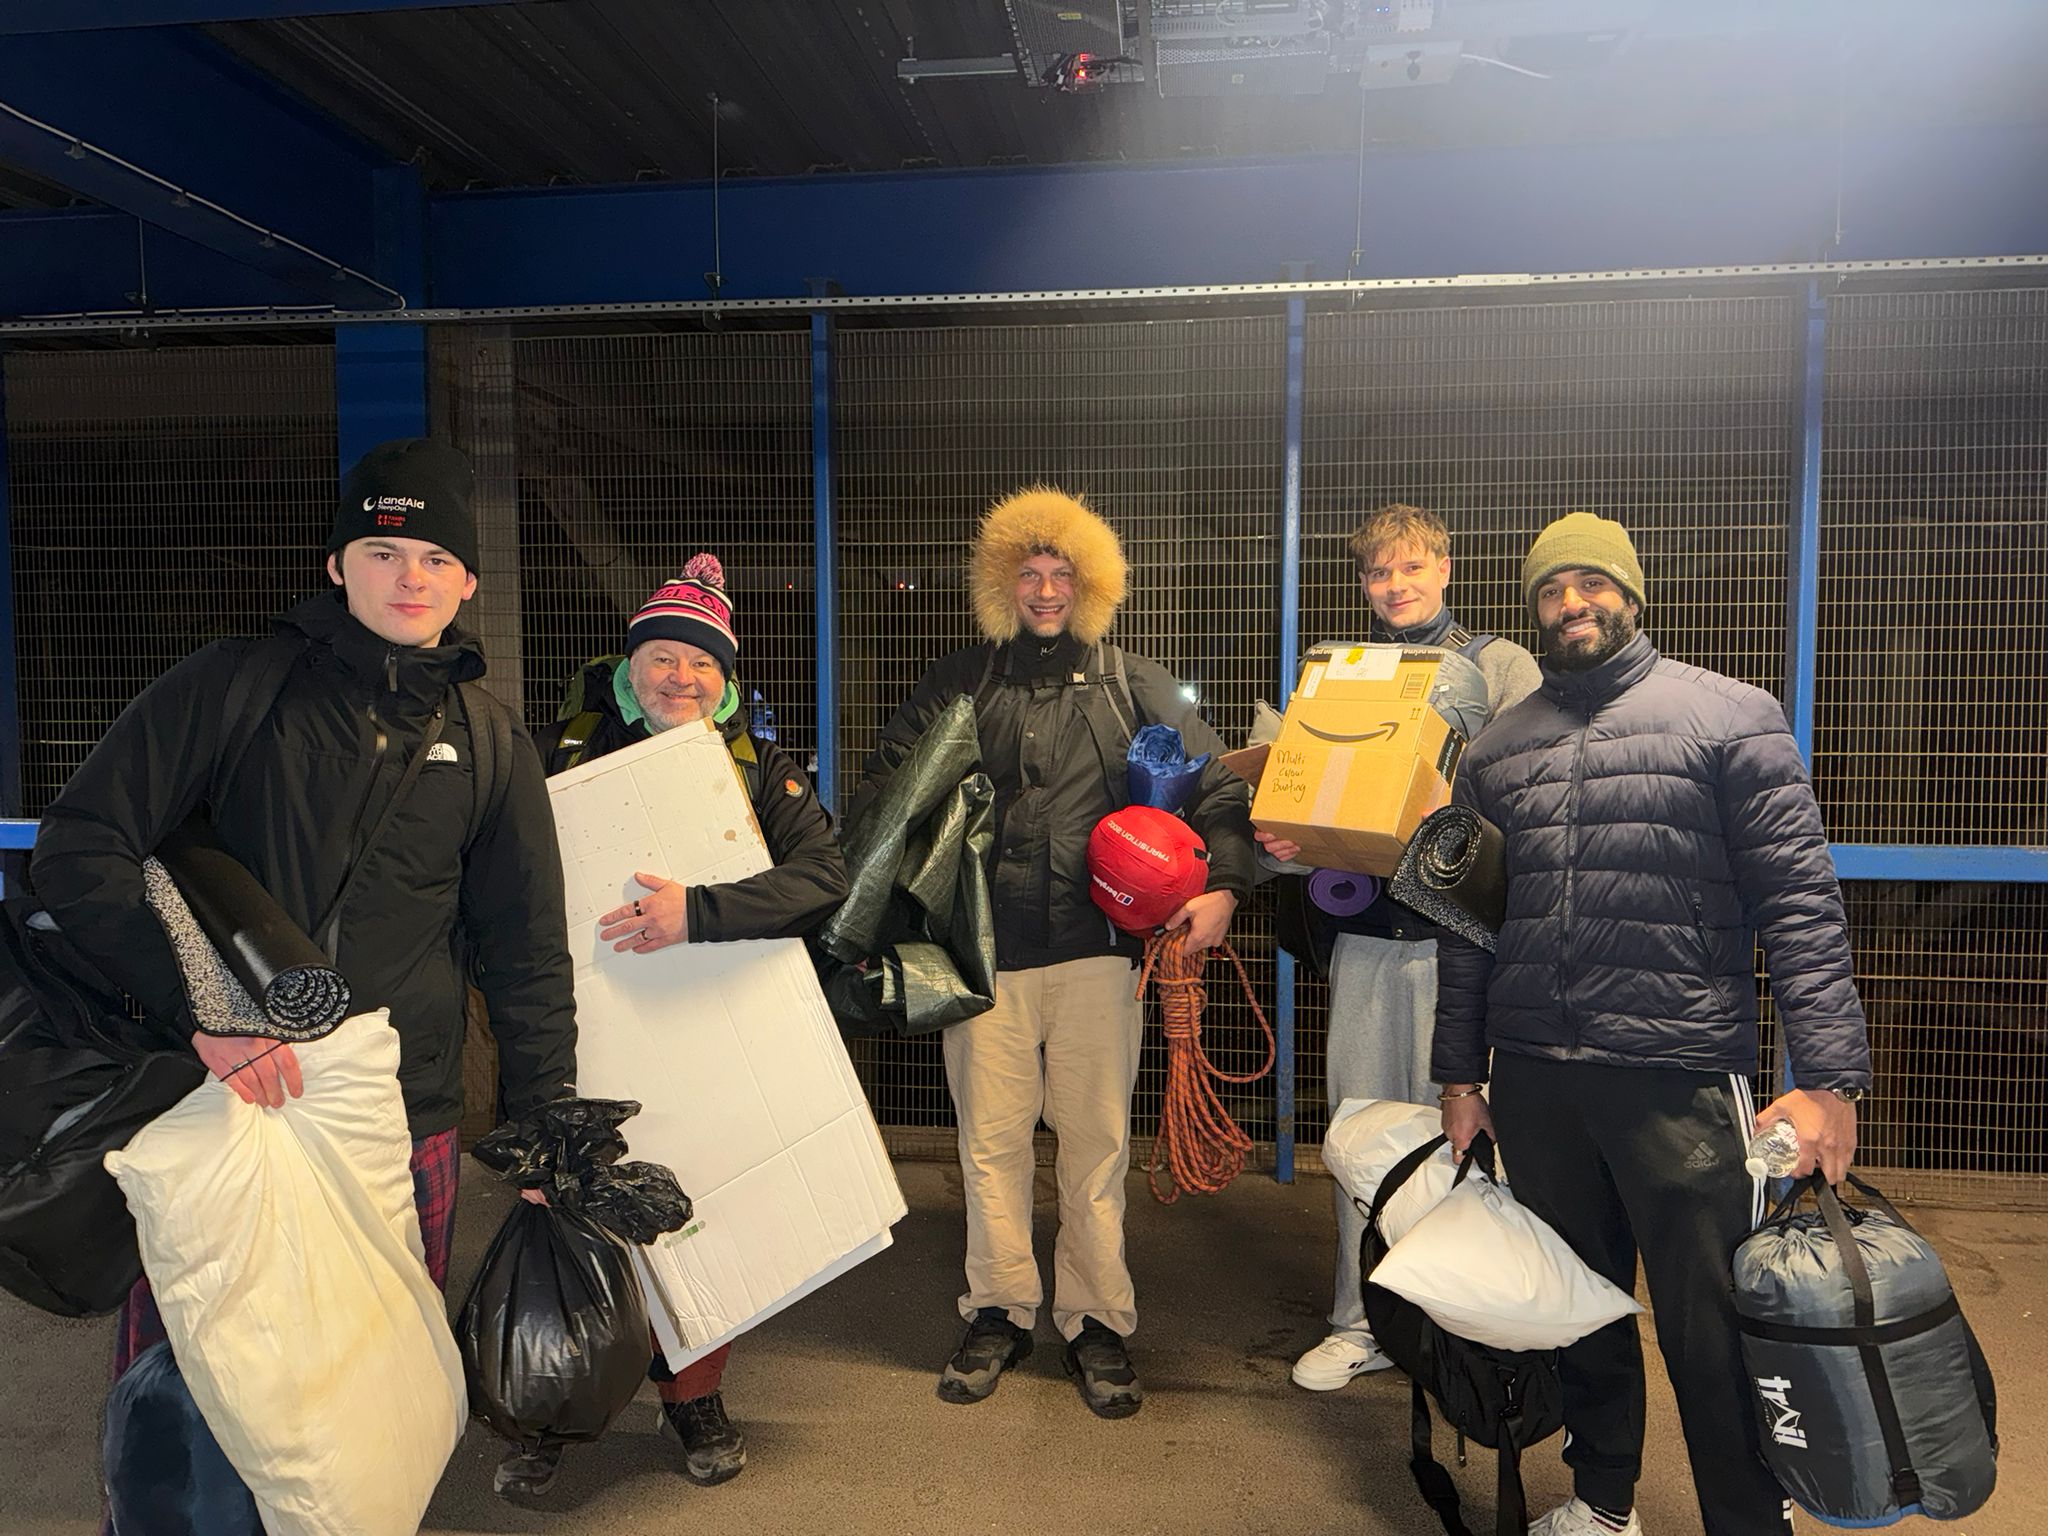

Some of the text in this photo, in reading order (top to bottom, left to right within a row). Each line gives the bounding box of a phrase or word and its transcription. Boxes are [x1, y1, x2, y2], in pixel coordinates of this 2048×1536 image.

[378, 495, 425, 510] LandAid
[1276, 749, 1305, 765] Multi
[1272, 777, 1306, 803] Bunting
